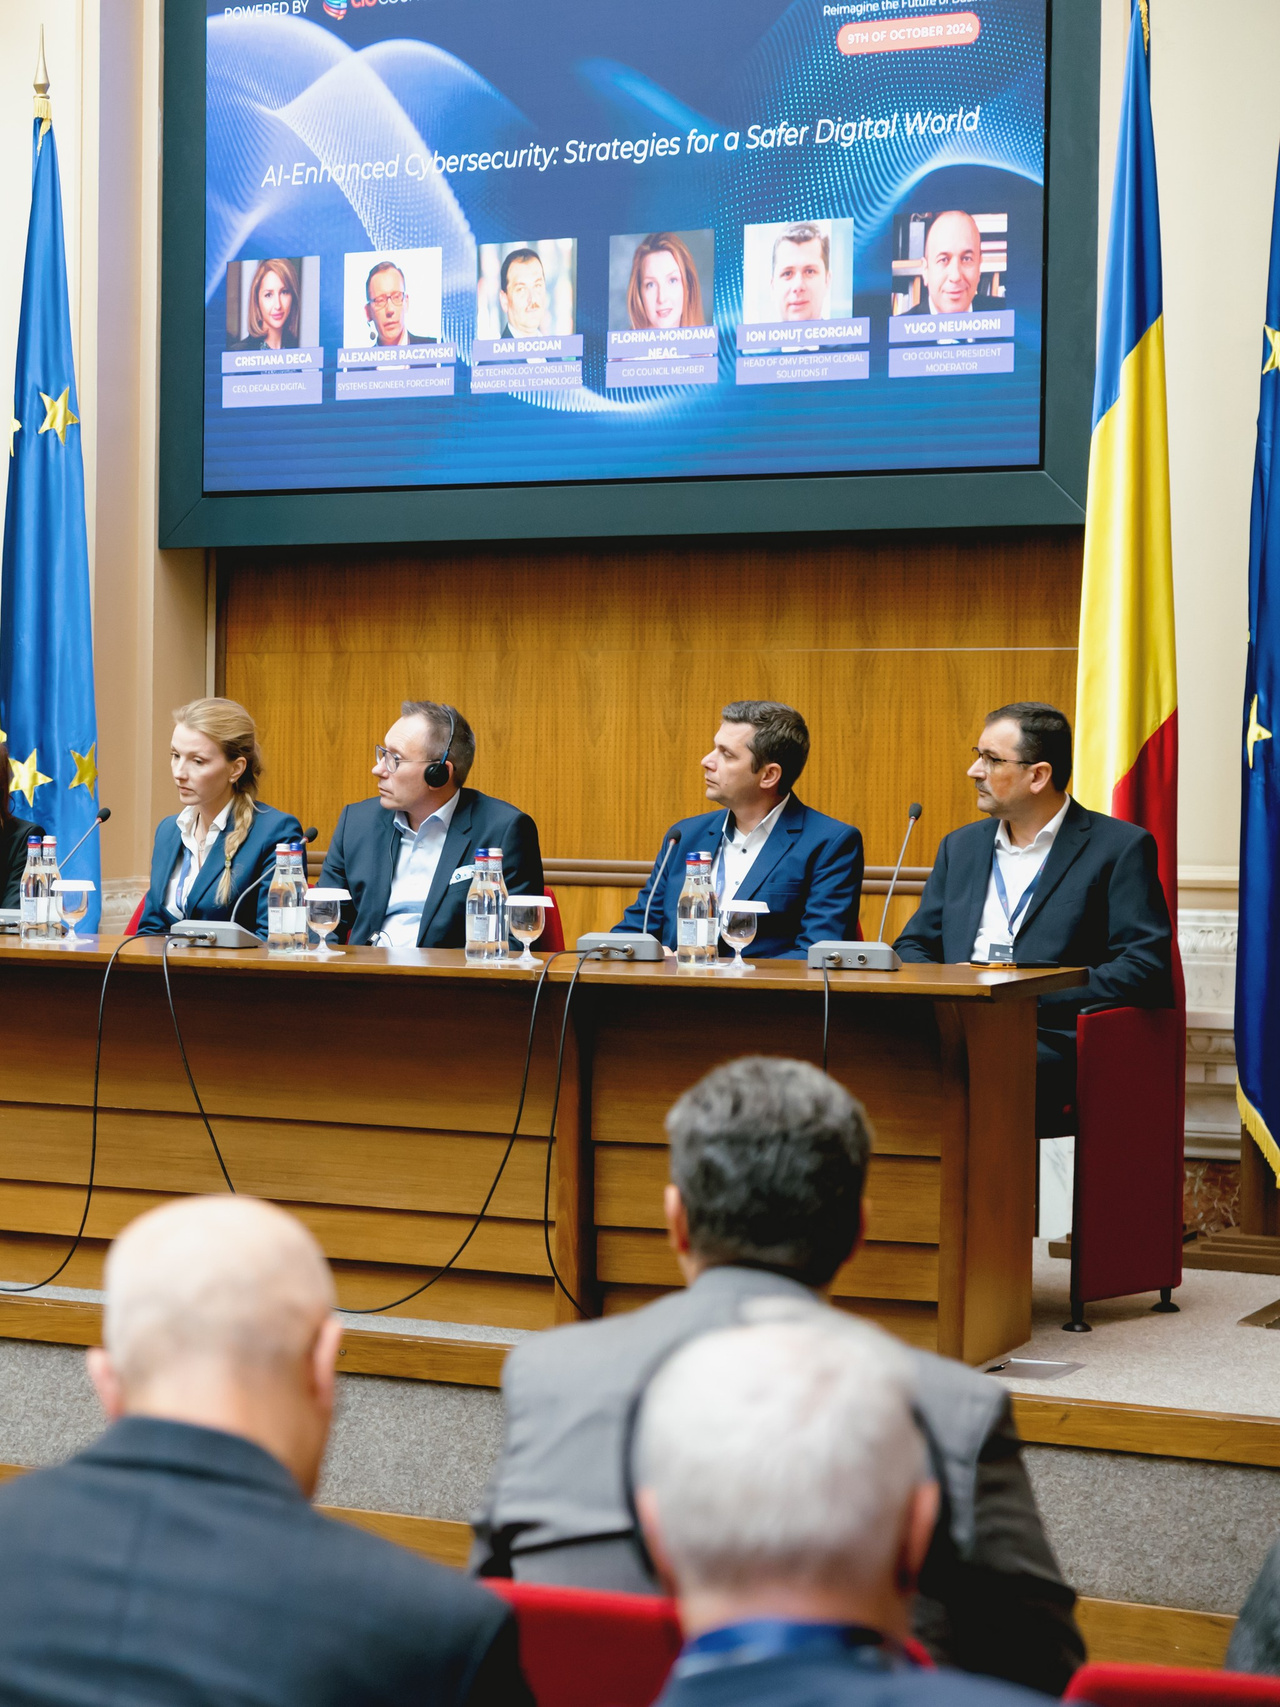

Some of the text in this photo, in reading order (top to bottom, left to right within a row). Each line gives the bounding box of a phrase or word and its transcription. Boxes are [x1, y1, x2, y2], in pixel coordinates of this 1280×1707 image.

[224, 0, 310, 20] POWERED BY
[823, 3, 880, 17] Reimagine
[881, 1, 898, 12] the
[848, 22, 973, 44] 9TH OF OCTOBER 2024
[261, 105, 981, 188] AI-Enhanced Cybersecurity: Strategies for a Safer Digital World
[746, 330, 767, 342] ION
[805, 324, 863, 340] GEORGIAN
[904, 318, 1001, 335] YUGO NEUMORNI
[493, 339, 562, 354] DAN BOGDAN
[902, 347, 1002, 361] CIO COUNCIL PRESIDENT
[235, 352, 312, 367] CRISTIANA DECA
[339, 347, 454, 363] ALEXANDER RACZYNSKI
[832, 353, 865, 364] GLOBAL
[636, 366, 670, 377] COUNCIL
[671, 364, 705, 375] MEMBER
[776, 368, 820, 379] SOLUTIONS
[925, 362, 978, 373] MODERATOR
[337, 381, 367, 392] SYSTEMS
[406, 377, 451, 388] FORCEPOINT
